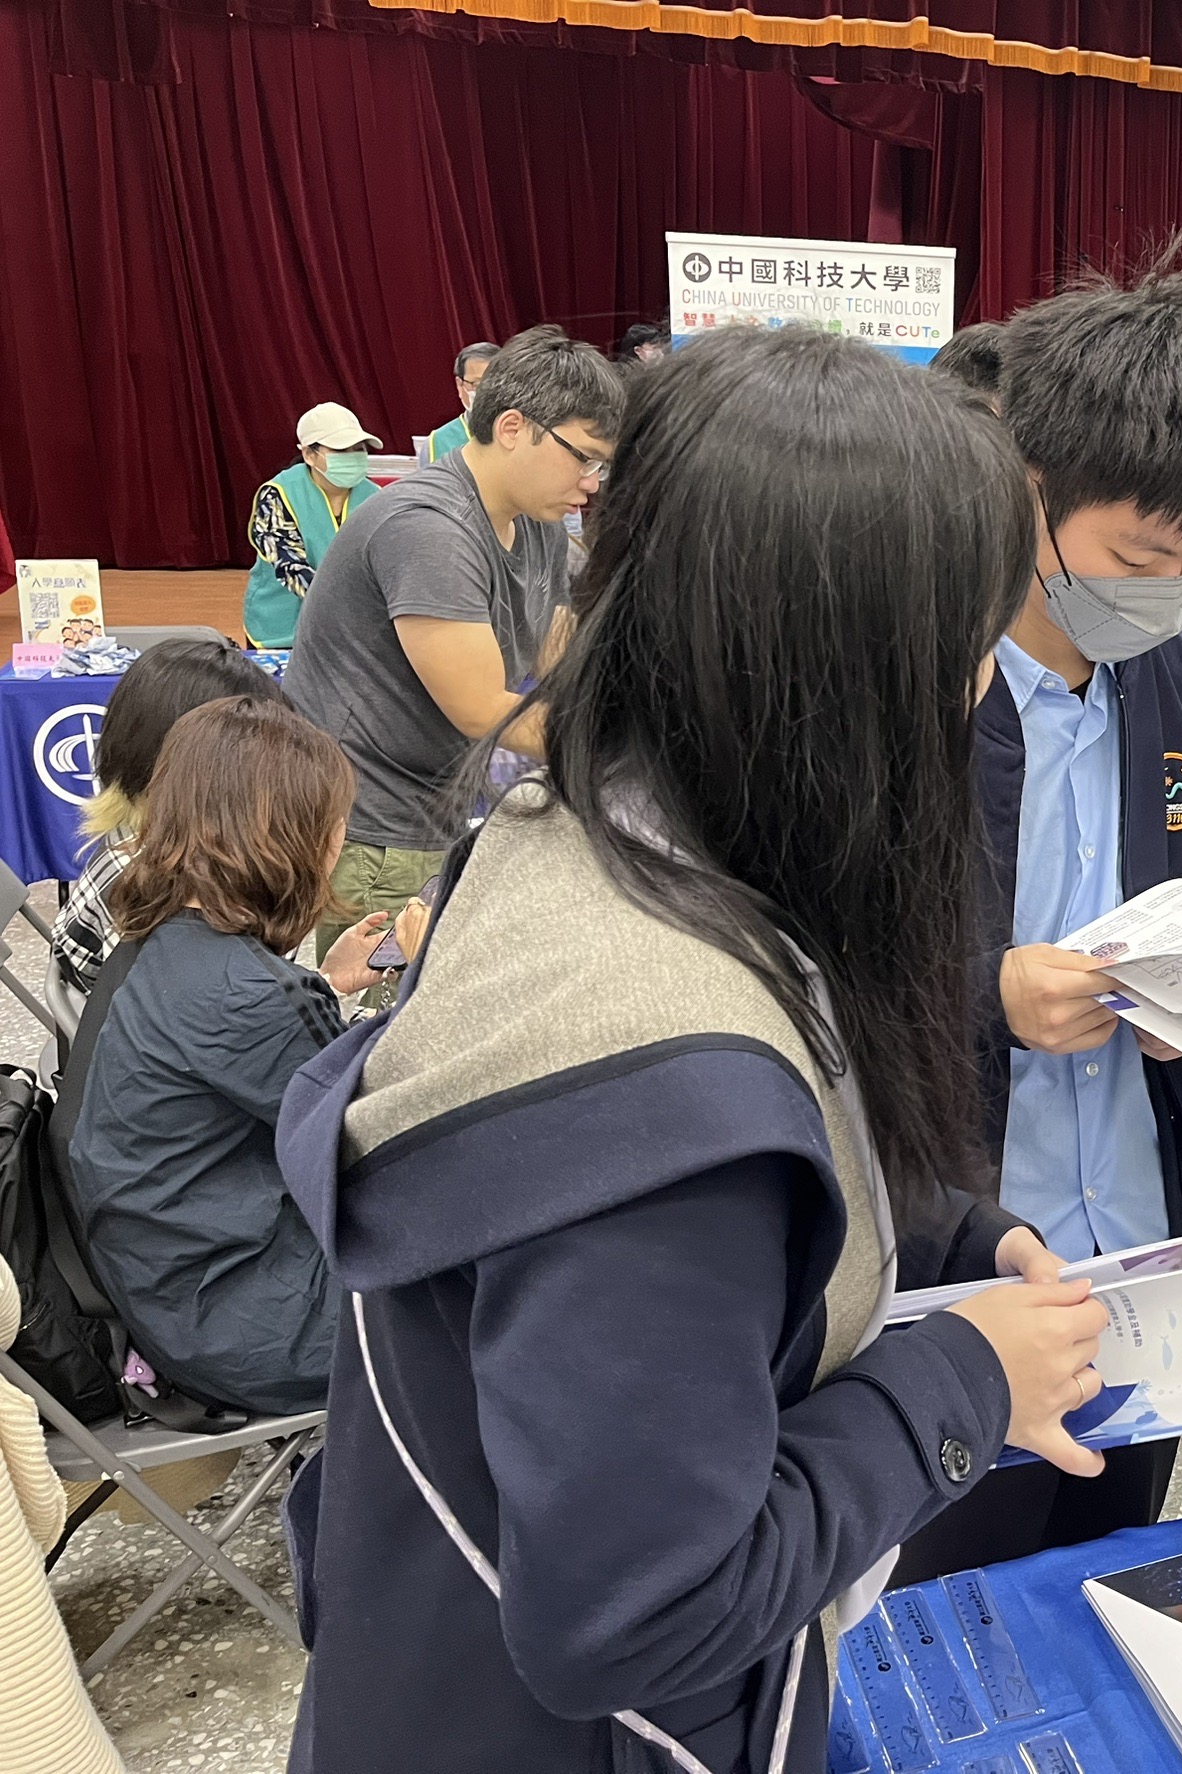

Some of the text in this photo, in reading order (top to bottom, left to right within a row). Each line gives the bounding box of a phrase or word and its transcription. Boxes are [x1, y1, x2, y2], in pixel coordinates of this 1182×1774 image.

[717, 255, 911, 293] 中國科技大學
[681, 288, 941, 317] CHINA UNIVERSITY OF TECHNOLOGY
